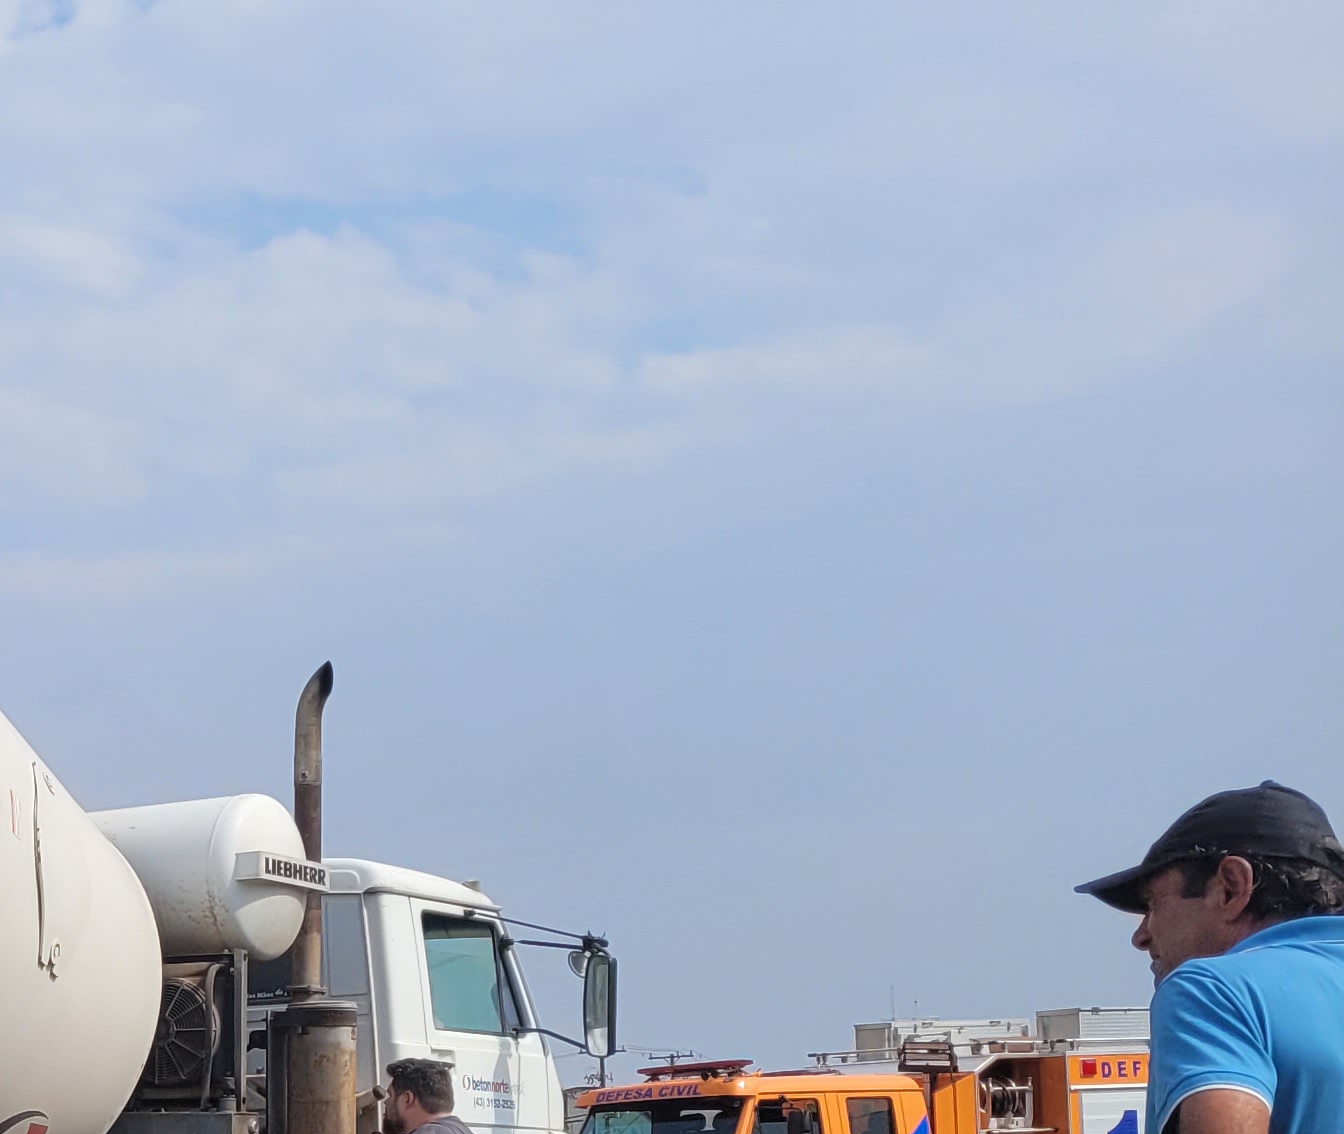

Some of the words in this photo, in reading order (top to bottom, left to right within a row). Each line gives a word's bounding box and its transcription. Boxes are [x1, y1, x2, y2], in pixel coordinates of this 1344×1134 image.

[265, 857, 326, 886] LIEBHERR
[472, 1075, 509, 1094] betonnorte
[596, 1087, 653, 1103] DEFESA
[658, 1084, 701, 1098] CIVIL
